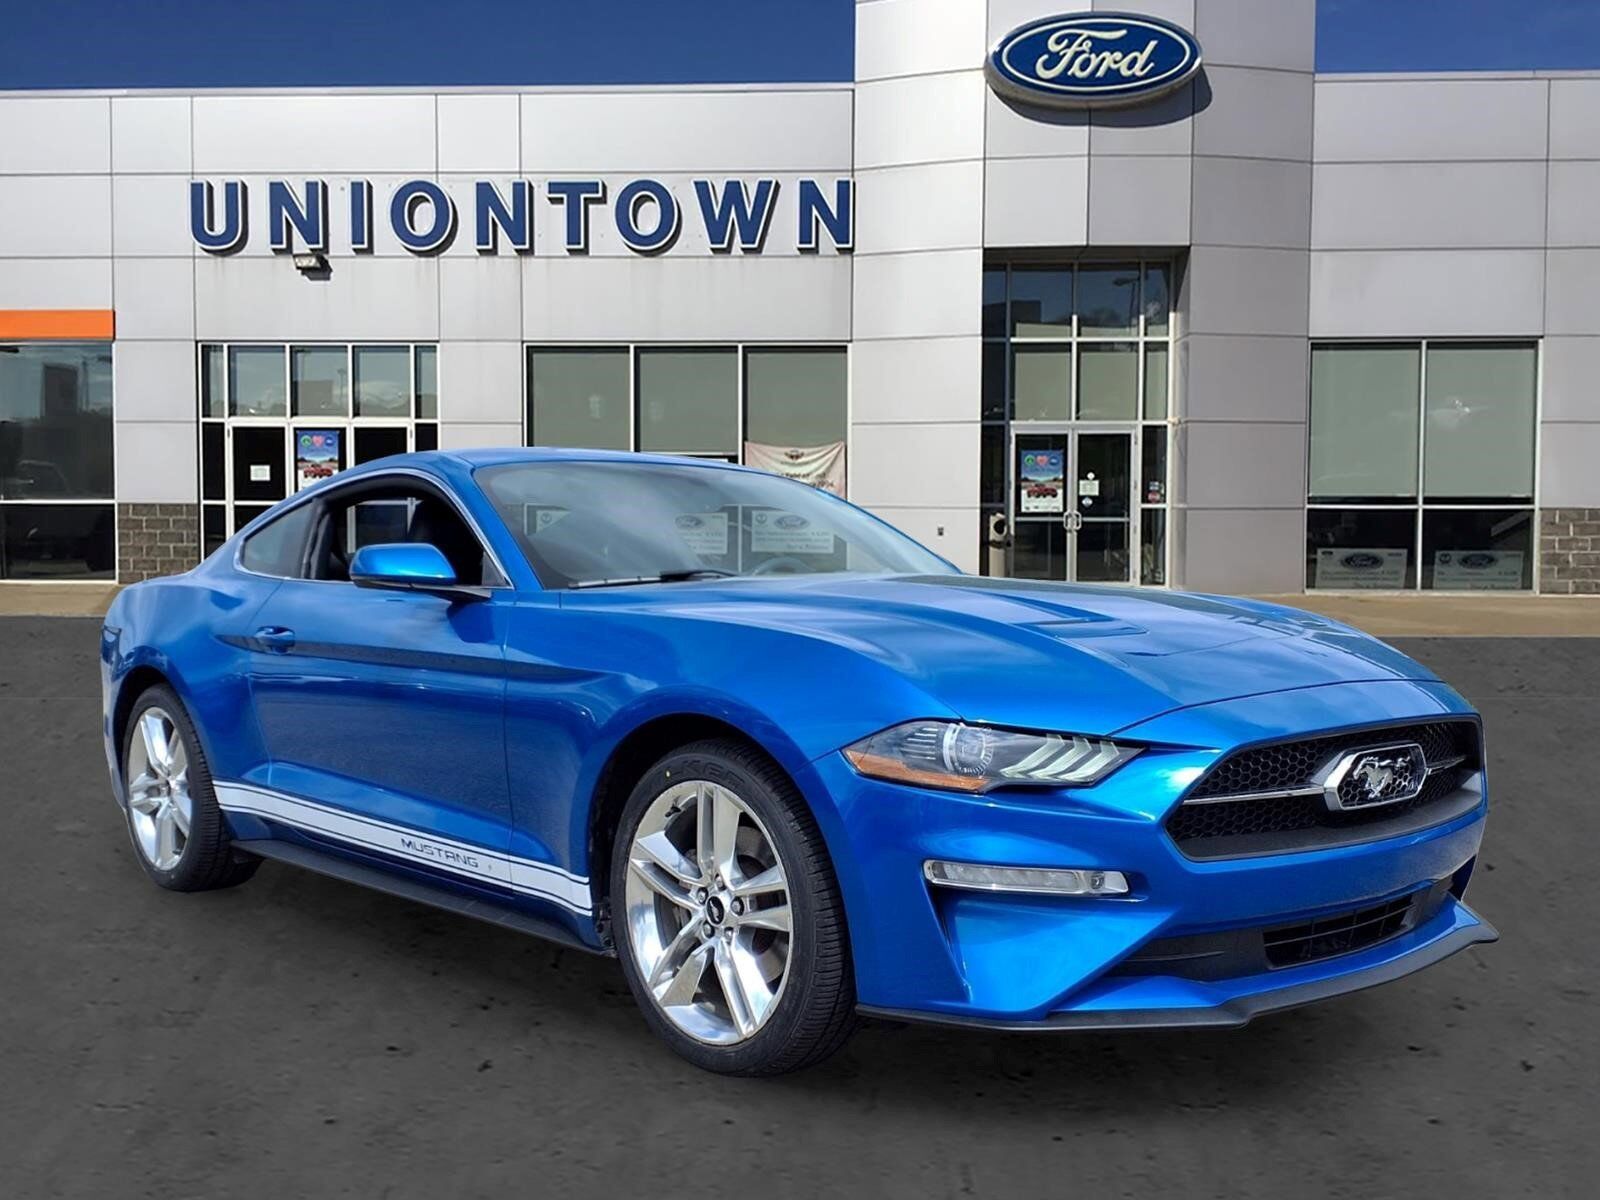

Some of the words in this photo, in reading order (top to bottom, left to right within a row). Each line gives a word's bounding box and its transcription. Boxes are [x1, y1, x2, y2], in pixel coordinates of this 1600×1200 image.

[1035, 29, 1158, 79] Ford
[190, 178, 854, 253] UNIONTOWN
[401, 838, 479, 868] MUSTANG
